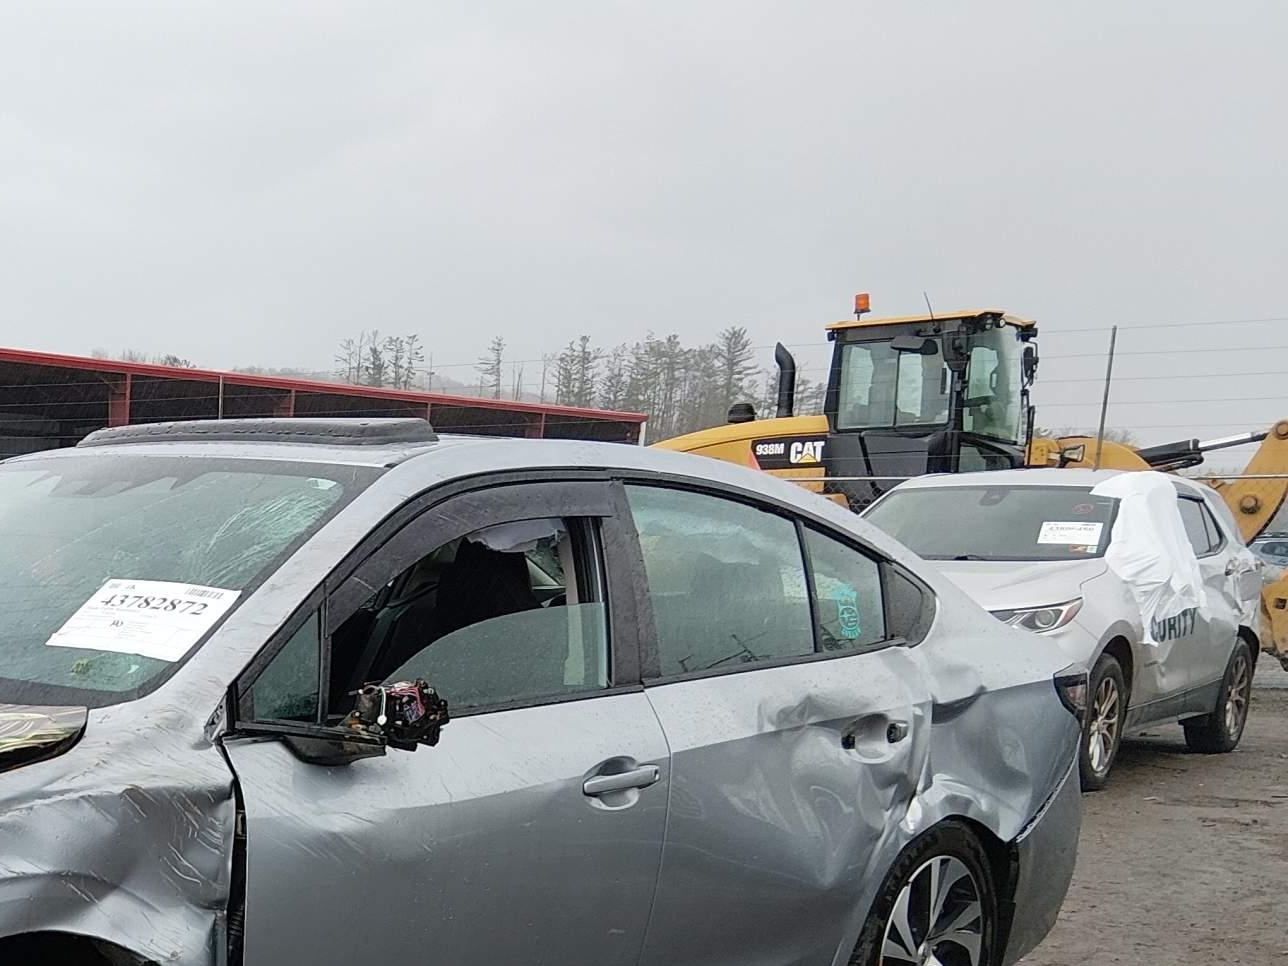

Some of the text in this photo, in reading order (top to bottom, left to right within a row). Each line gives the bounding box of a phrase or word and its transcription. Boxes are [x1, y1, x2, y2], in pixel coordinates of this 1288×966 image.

[756, 441, 825, 464] 938M CAT
[101, 594, 209, 616] 43782872
